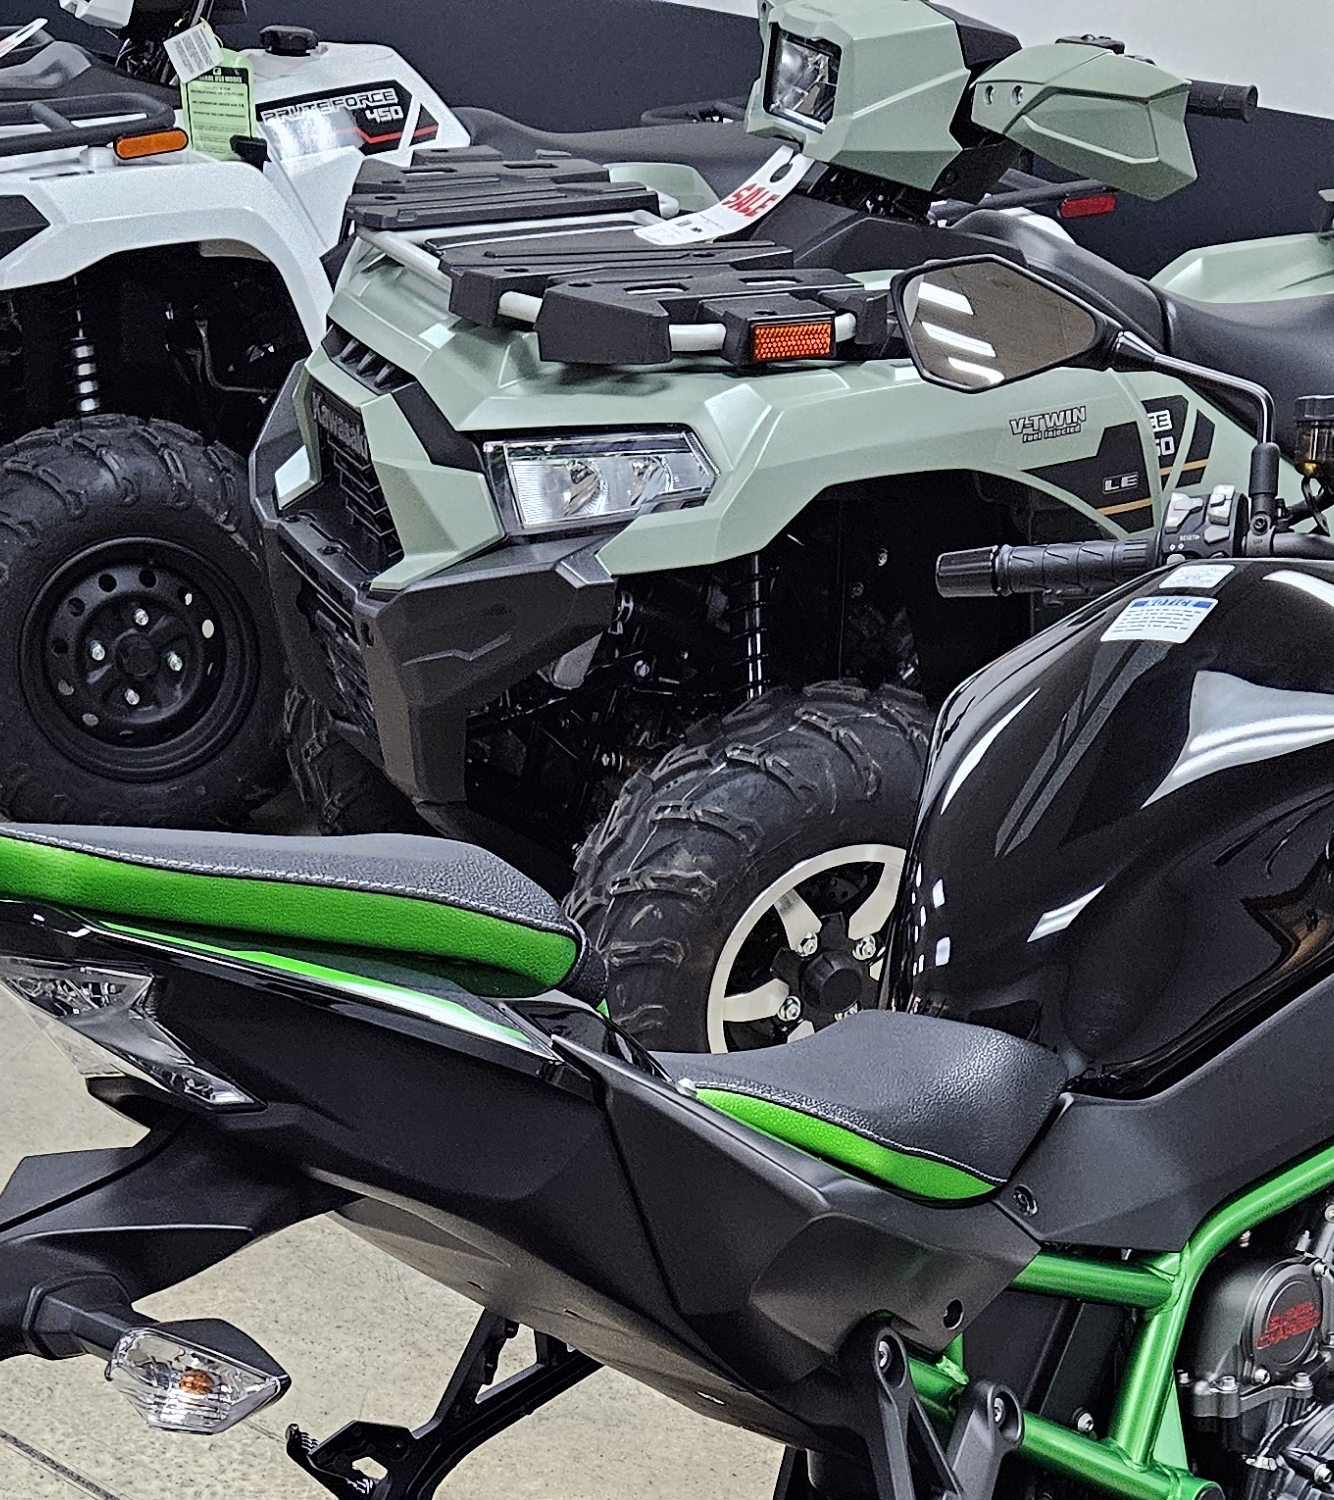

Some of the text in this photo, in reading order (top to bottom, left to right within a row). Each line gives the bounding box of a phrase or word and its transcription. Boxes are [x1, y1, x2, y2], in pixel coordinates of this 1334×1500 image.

[261, 87, 399, 123] BRUTE FORCE
[366, 105, 404, 123] 450
[720, 183, 781, 218] SALE
[1009, 405, 1087, 435] V-TWIN
[1104, 473, 1138, 491] LE
